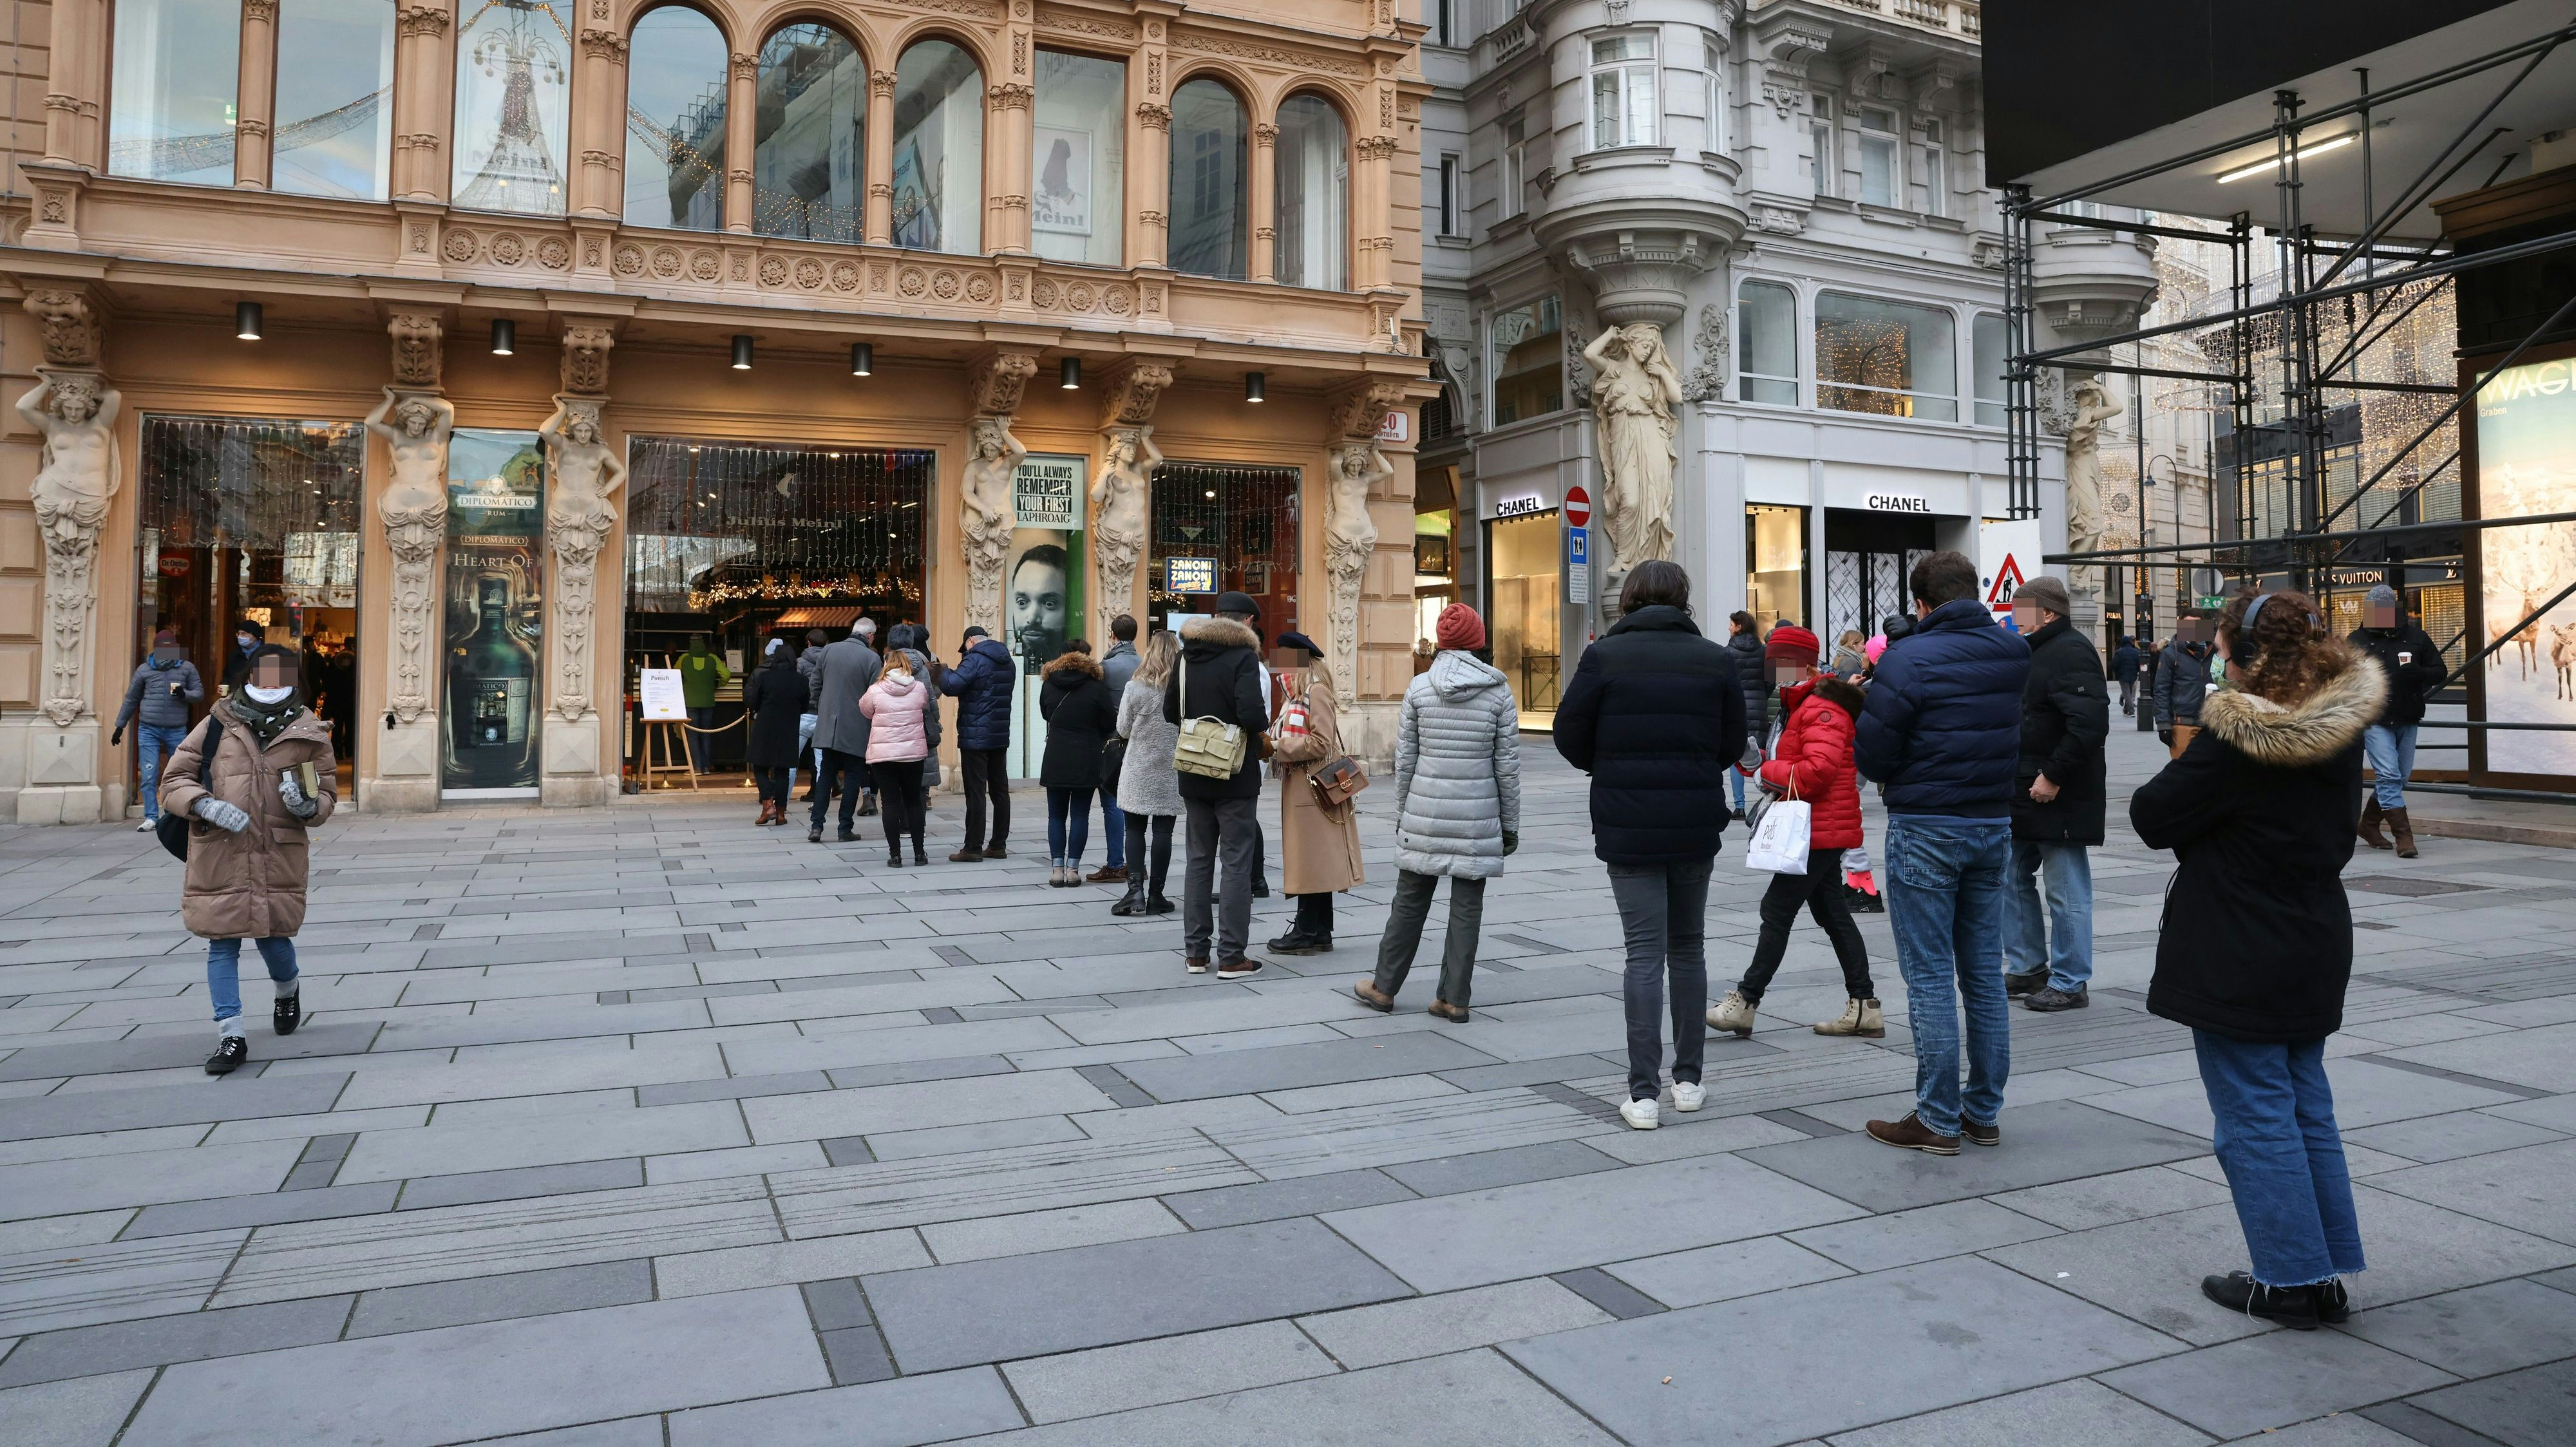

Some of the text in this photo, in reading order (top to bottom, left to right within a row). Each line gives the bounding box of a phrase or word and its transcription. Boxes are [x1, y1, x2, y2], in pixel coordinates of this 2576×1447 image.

[2478, 359, 2576, 404] WAG
[2480, 406, 2507, 417] Graben
[1018, 464, 1072, 479] YOU'LL ALWAYS
[1017, 478, 1072, 496] REMEMBER
[1019, 496, 1070, 513] YOUR FIRST
[1496, 497, 1539, 516] CHANEL
[1869, 495, 1931, 512] CHANEL
[1017, 512, 1070, 524] LAPHROAIG
[1171, 560, 1212, 571] ZANONI
[1171, 571, 1212, 581] ZANONI
[2339, 571, 2382, 585] VUITTON
